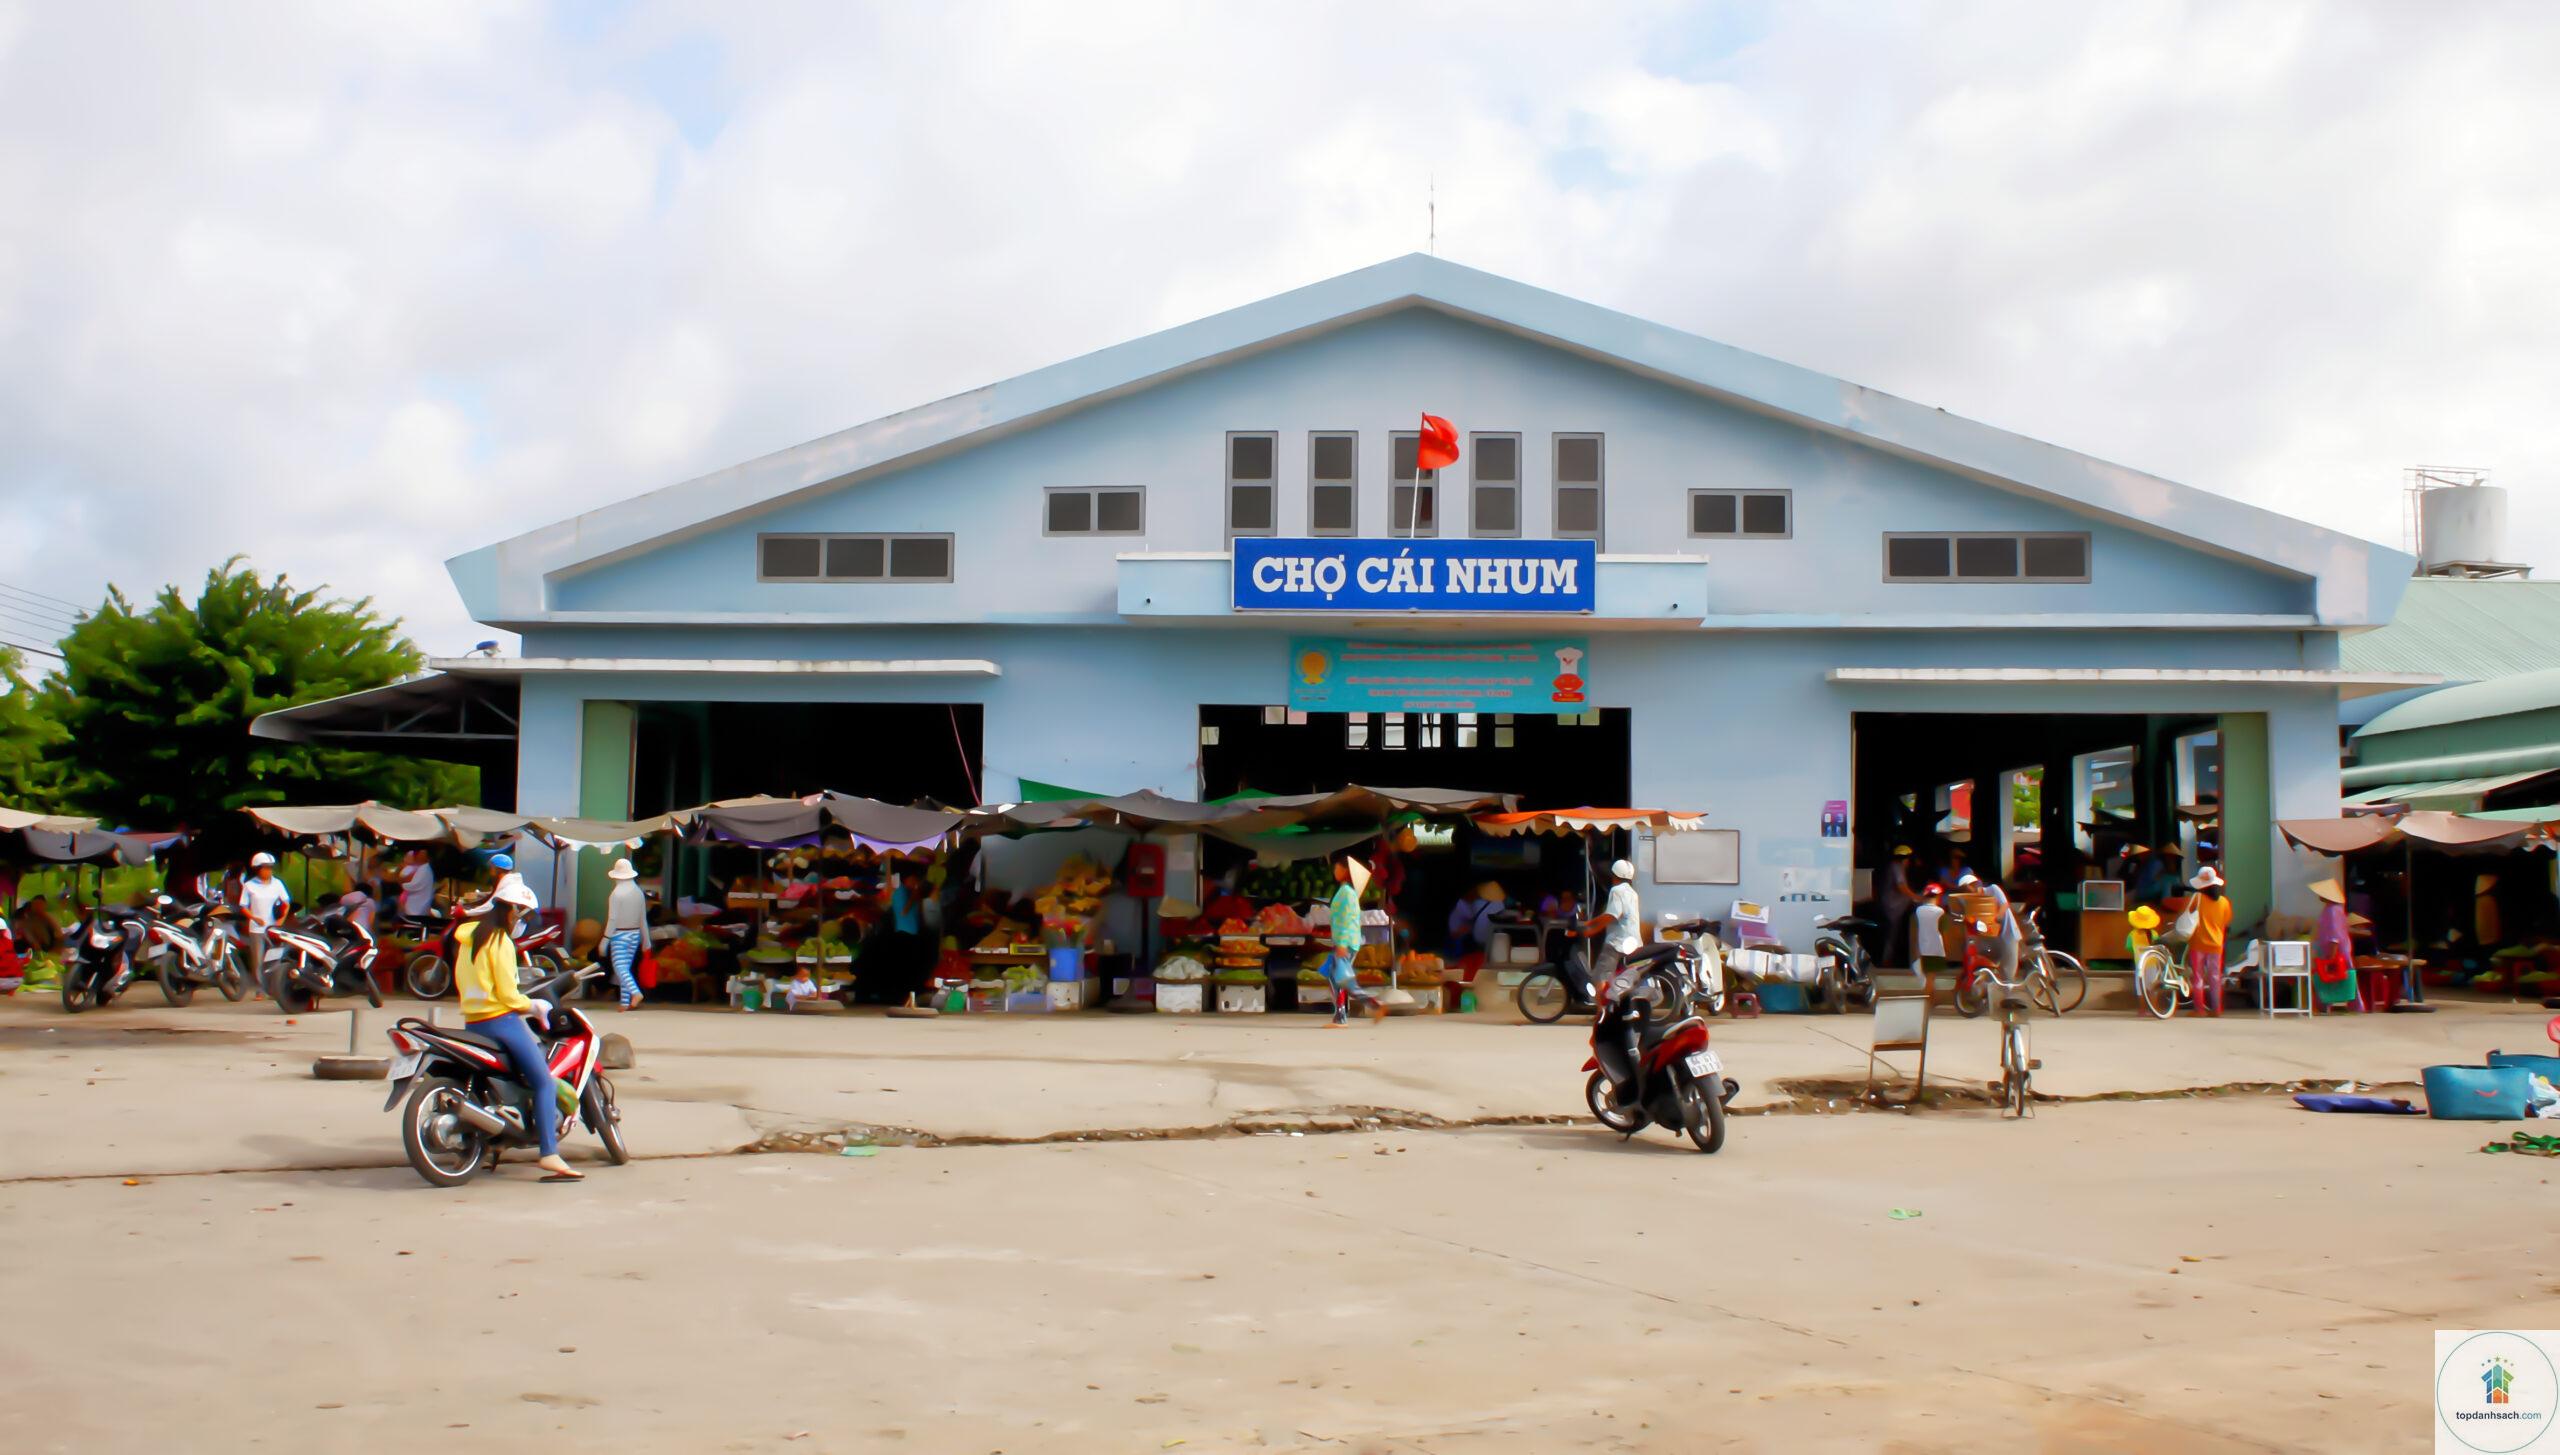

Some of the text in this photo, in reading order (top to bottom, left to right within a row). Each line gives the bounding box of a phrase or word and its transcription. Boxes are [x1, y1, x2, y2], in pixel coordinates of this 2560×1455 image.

[1252, 547, 1578, 601] CHỢ CÁI NHUM
